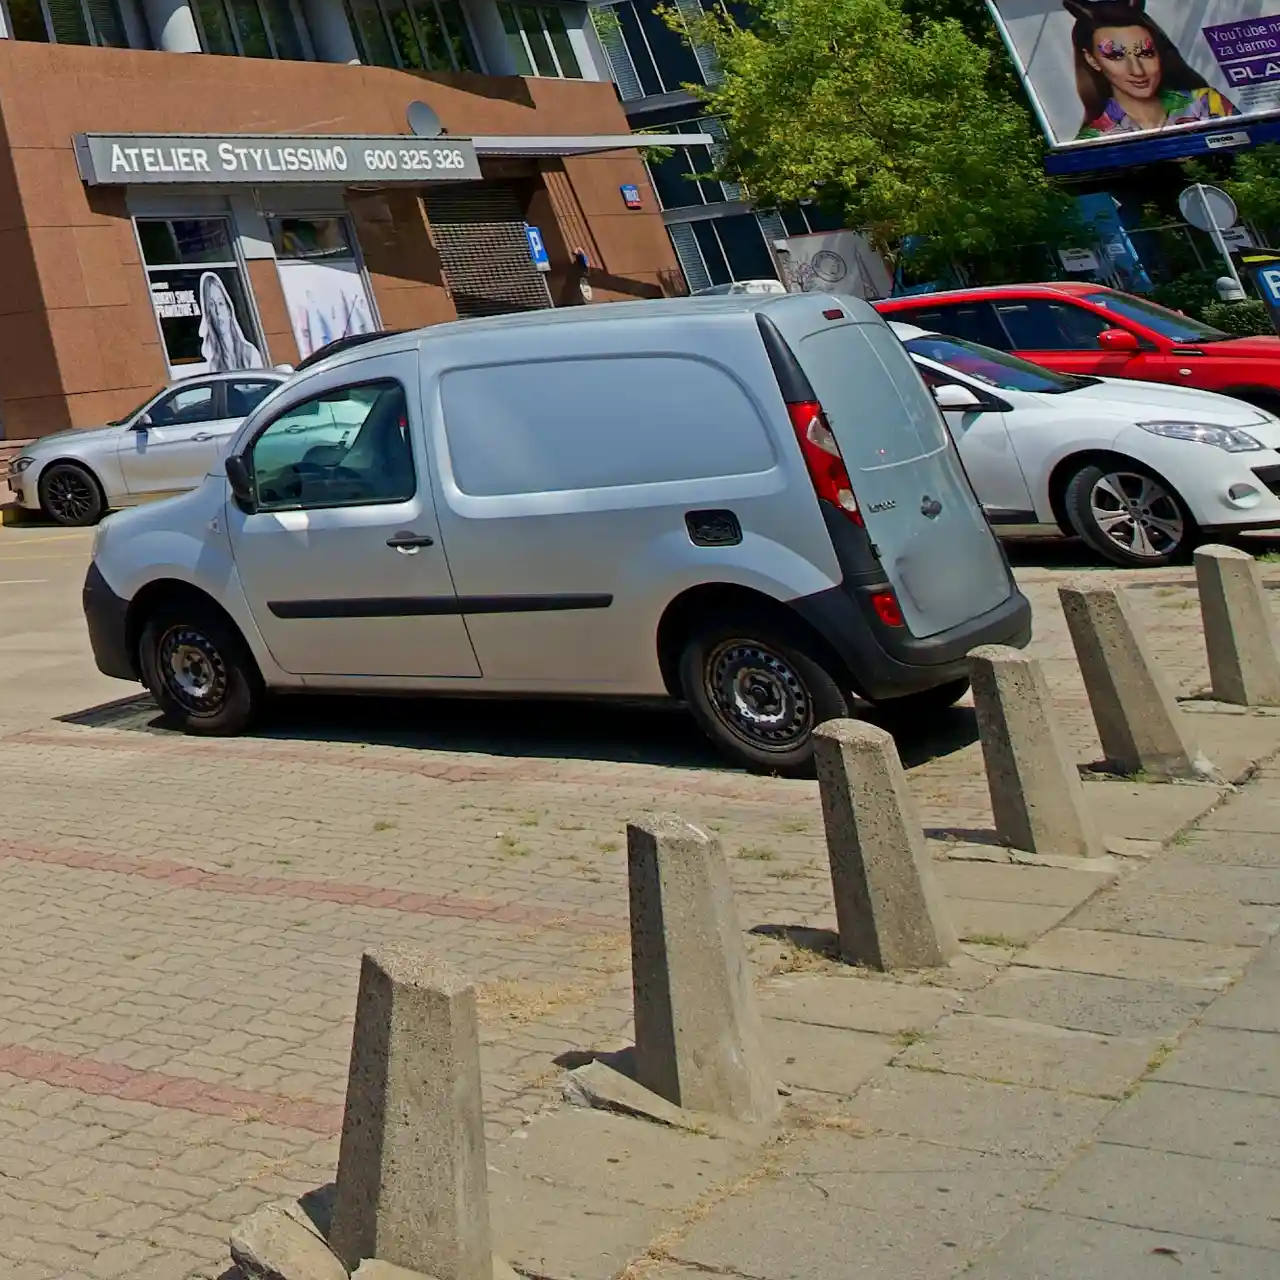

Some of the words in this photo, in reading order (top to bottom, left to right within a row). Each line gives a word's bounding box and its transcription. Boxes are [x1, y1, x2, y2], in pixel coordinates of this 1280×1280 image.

[1209, 25, 1268, 42] YouTube
[1217, 46, 1234, 56] za
[1236, 39, 1277, 53] darmo
[1228, 61, 1280, 82] PLA
[111, 143, 211, 173] ATELIER
[218, 142, 348, 172] STYLISSIMO
[364, 149, 397, 170] 600
[400, 149, 432, 170] 325
[435, 149, 465, 170] 326
